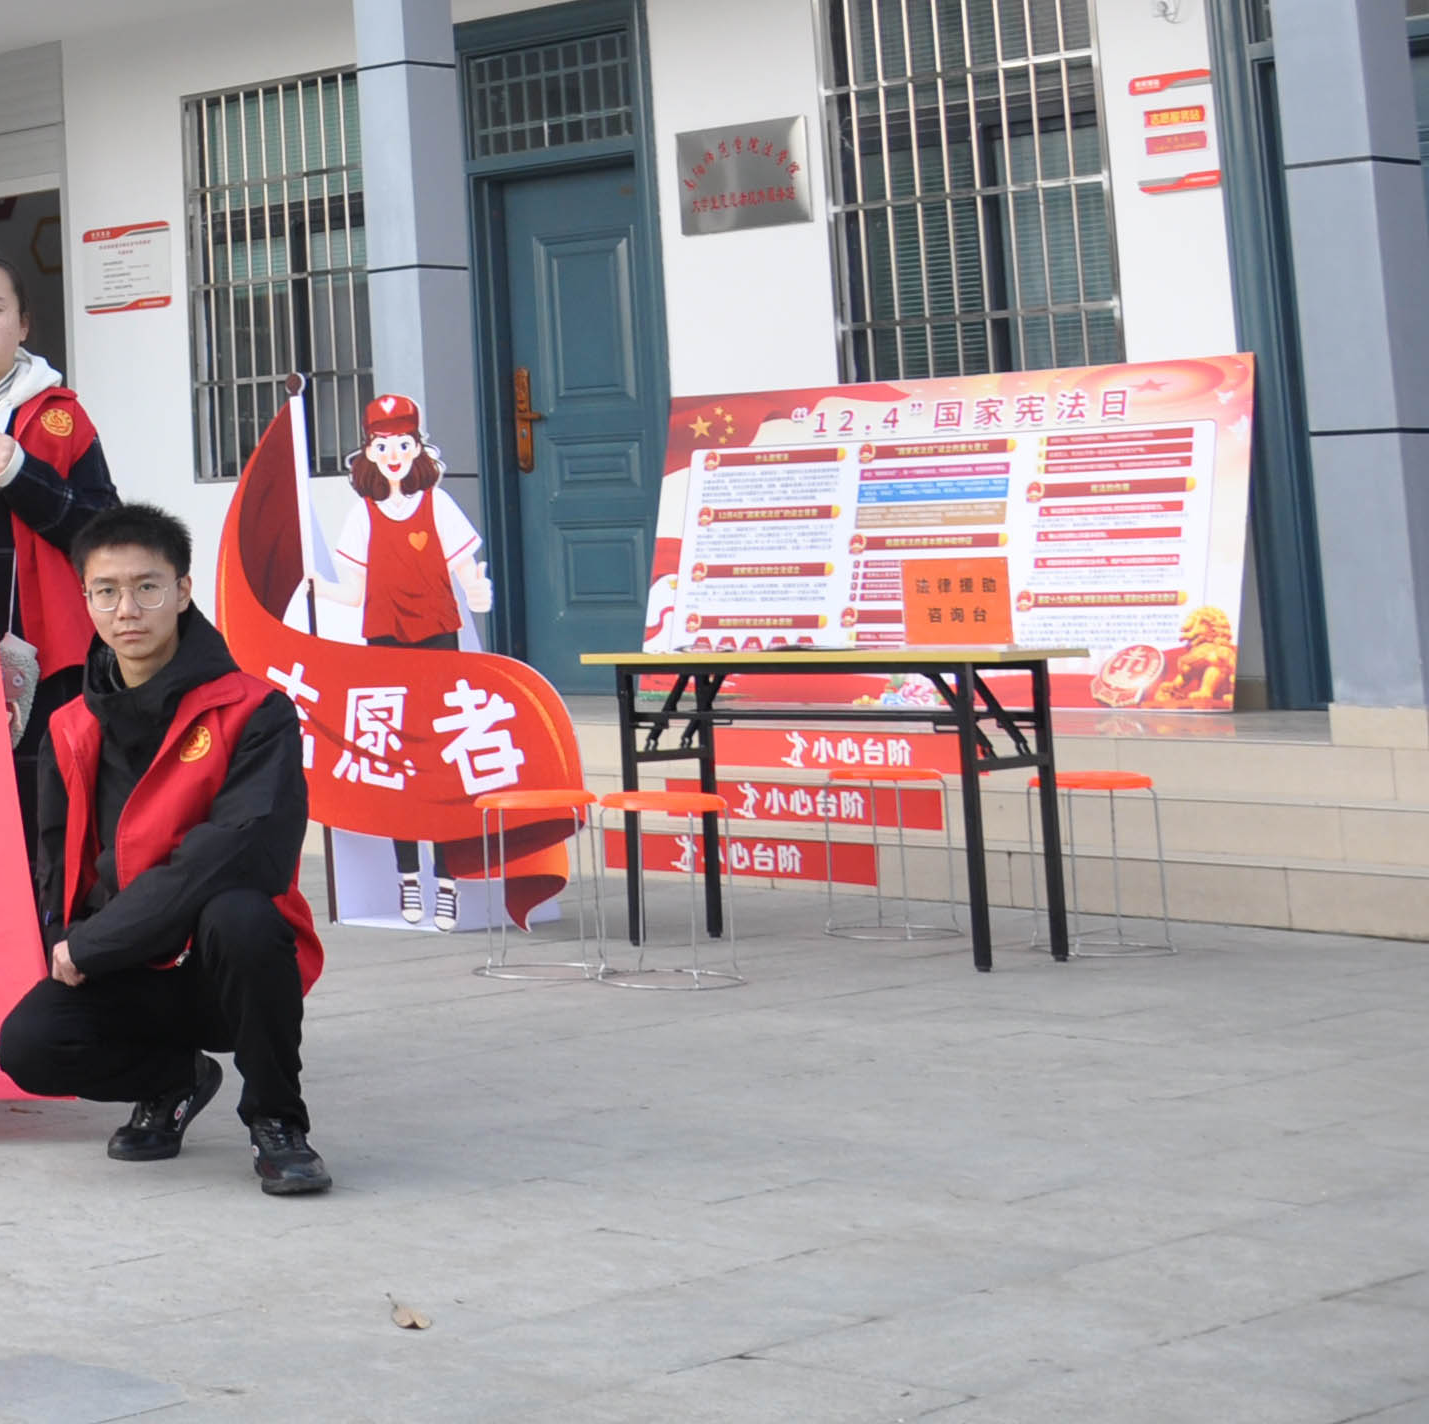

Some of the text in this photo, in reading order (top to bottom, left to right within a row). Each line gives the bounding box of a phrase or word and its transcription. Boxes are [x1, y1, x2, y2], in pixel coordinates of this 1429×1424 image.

[916, 578, 997, 594] 法律援助
[928, 607, 987, 623] 咨询台
[811, 737, 912, 768] 小心台阶
[763, 787, 865, 820] 小心台阶
